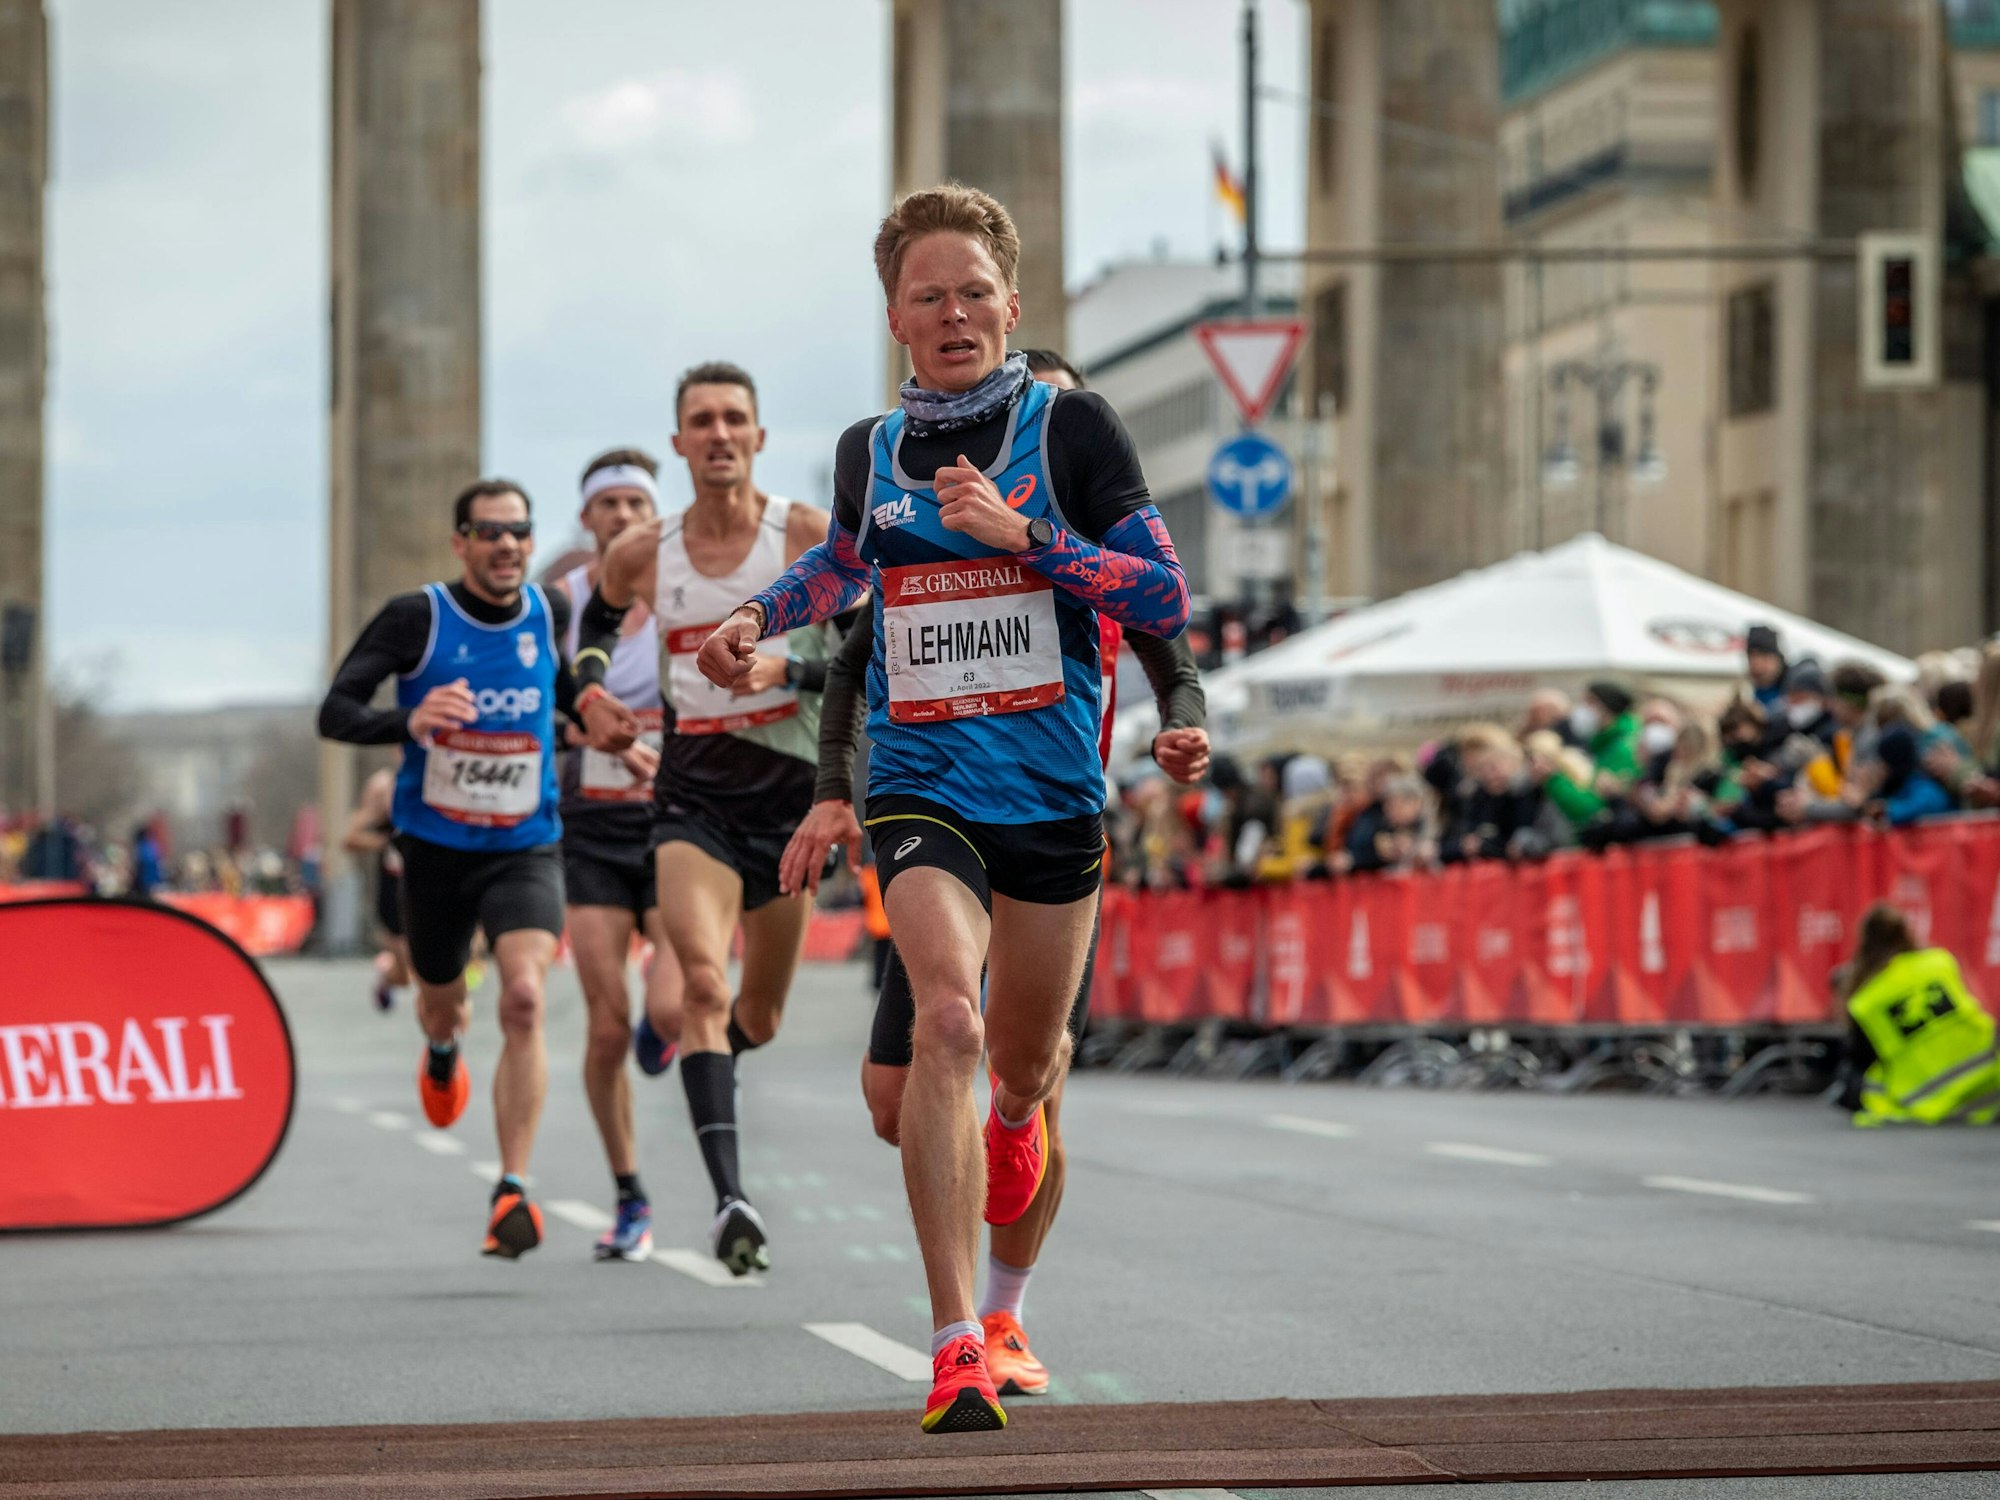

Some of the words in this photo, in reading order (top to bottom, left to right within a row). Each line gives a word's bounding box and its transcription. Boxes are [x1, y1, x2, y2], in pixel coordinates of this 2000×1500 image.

[926, 565, 1024, 593] GENERALI
[908, 614, 1031, 666] LEHMANN
[957, 684, 973, 692] April
[974, 682, 991, 690] 2022
[963, 672, 975, 682] 63
[452, 760, 528, 789] 15447
[0, 1013, 245, 1110] ERALI
